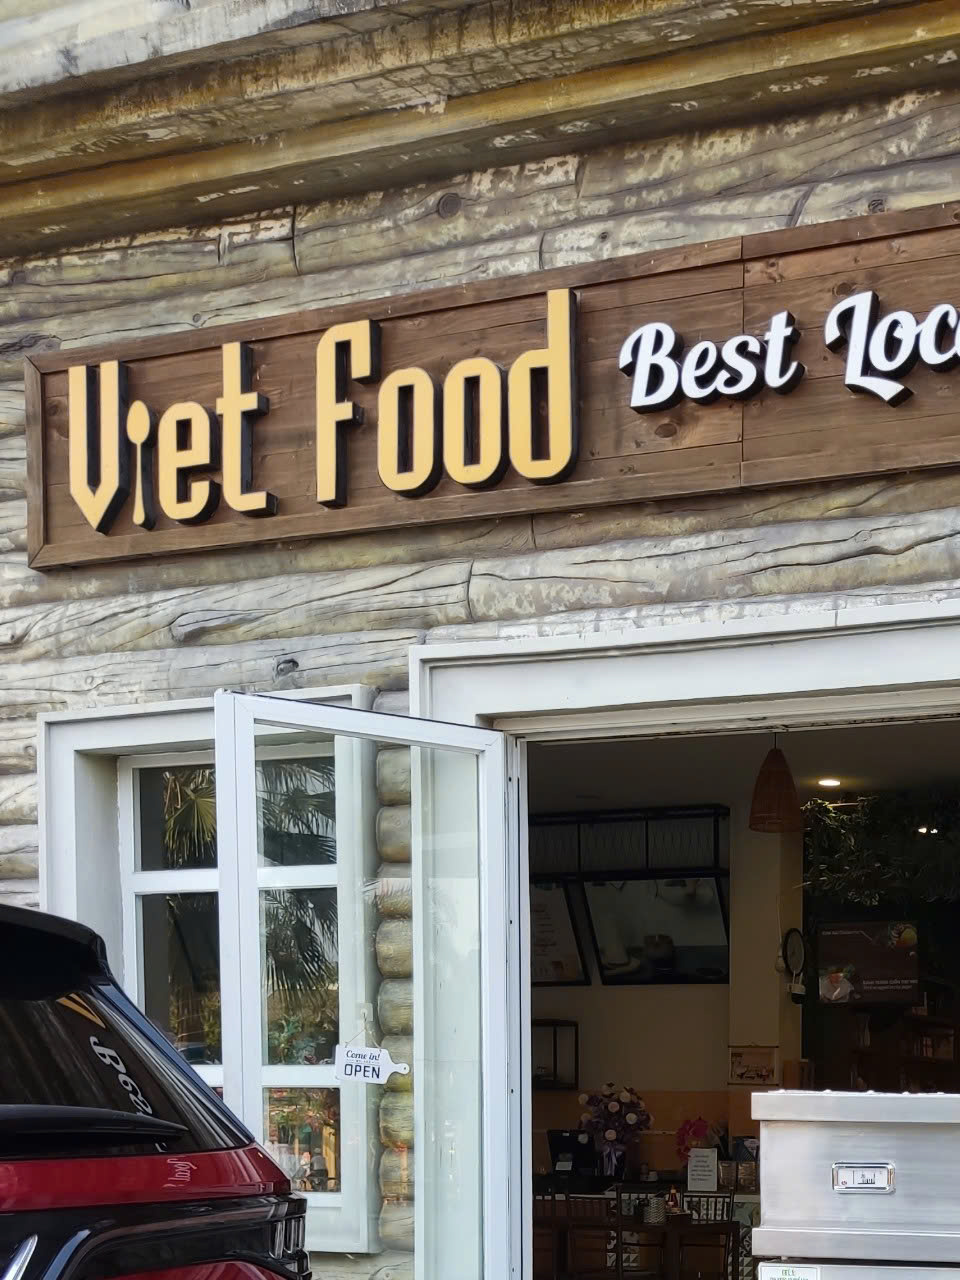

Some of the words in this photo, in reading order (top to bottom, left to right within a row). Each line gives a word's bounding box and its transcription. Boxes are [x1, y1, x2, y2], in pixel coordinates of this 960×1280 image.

[68, 341, 270, 533] Viet
[619, 311, 800, 412] Best
[346, 1050, 367, 1060] Come
[369, 1053, 380, 1061] in!
[344, 1063, 380, 1078] OPEN
